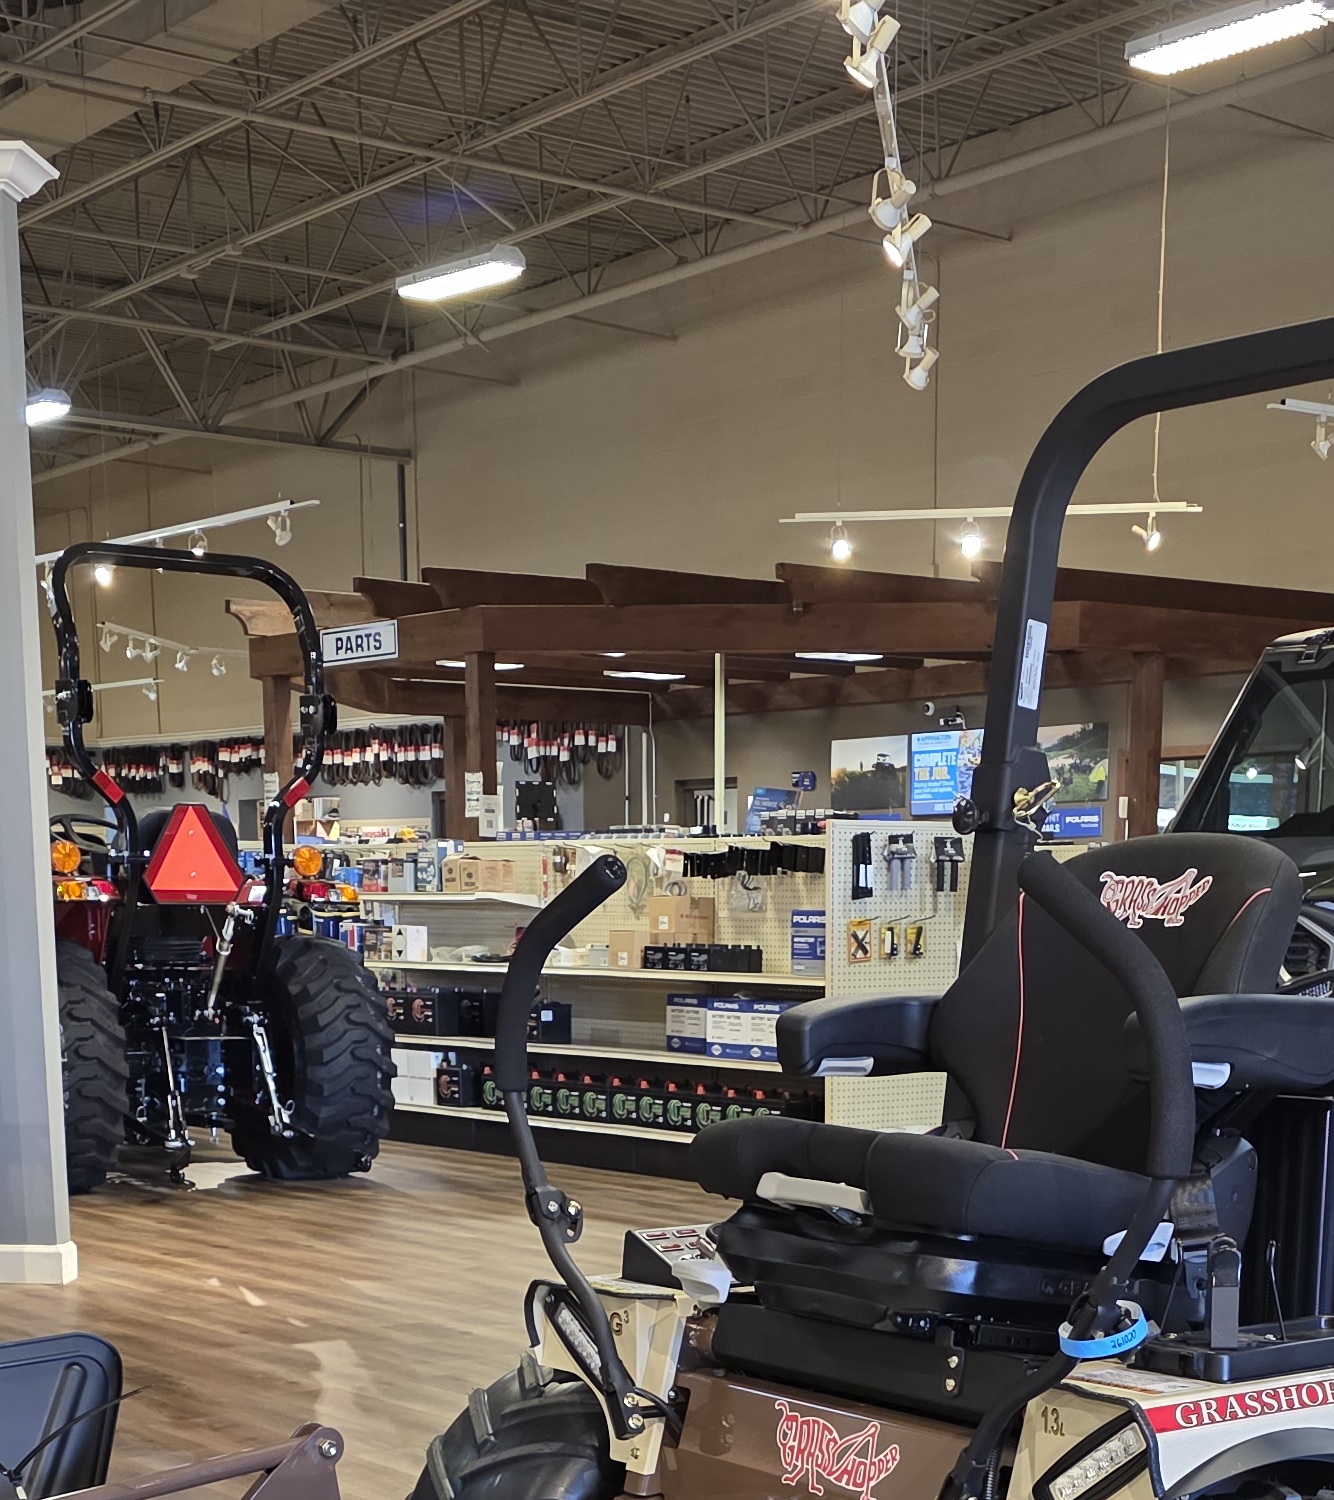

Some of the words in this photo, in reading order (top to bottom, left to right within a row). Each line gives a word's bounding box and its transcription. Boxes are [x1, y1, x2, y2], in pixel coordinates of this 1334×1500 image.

[335, 632, 383, 656] PARTS
[914, 751, 956, 768] COMPLETE
[1066, 815, 1099, 824] POLARIS
[714, 1002, 739, 1010] POLARIS
[776, 1408, 900, 1495] GRASSHOPPER
